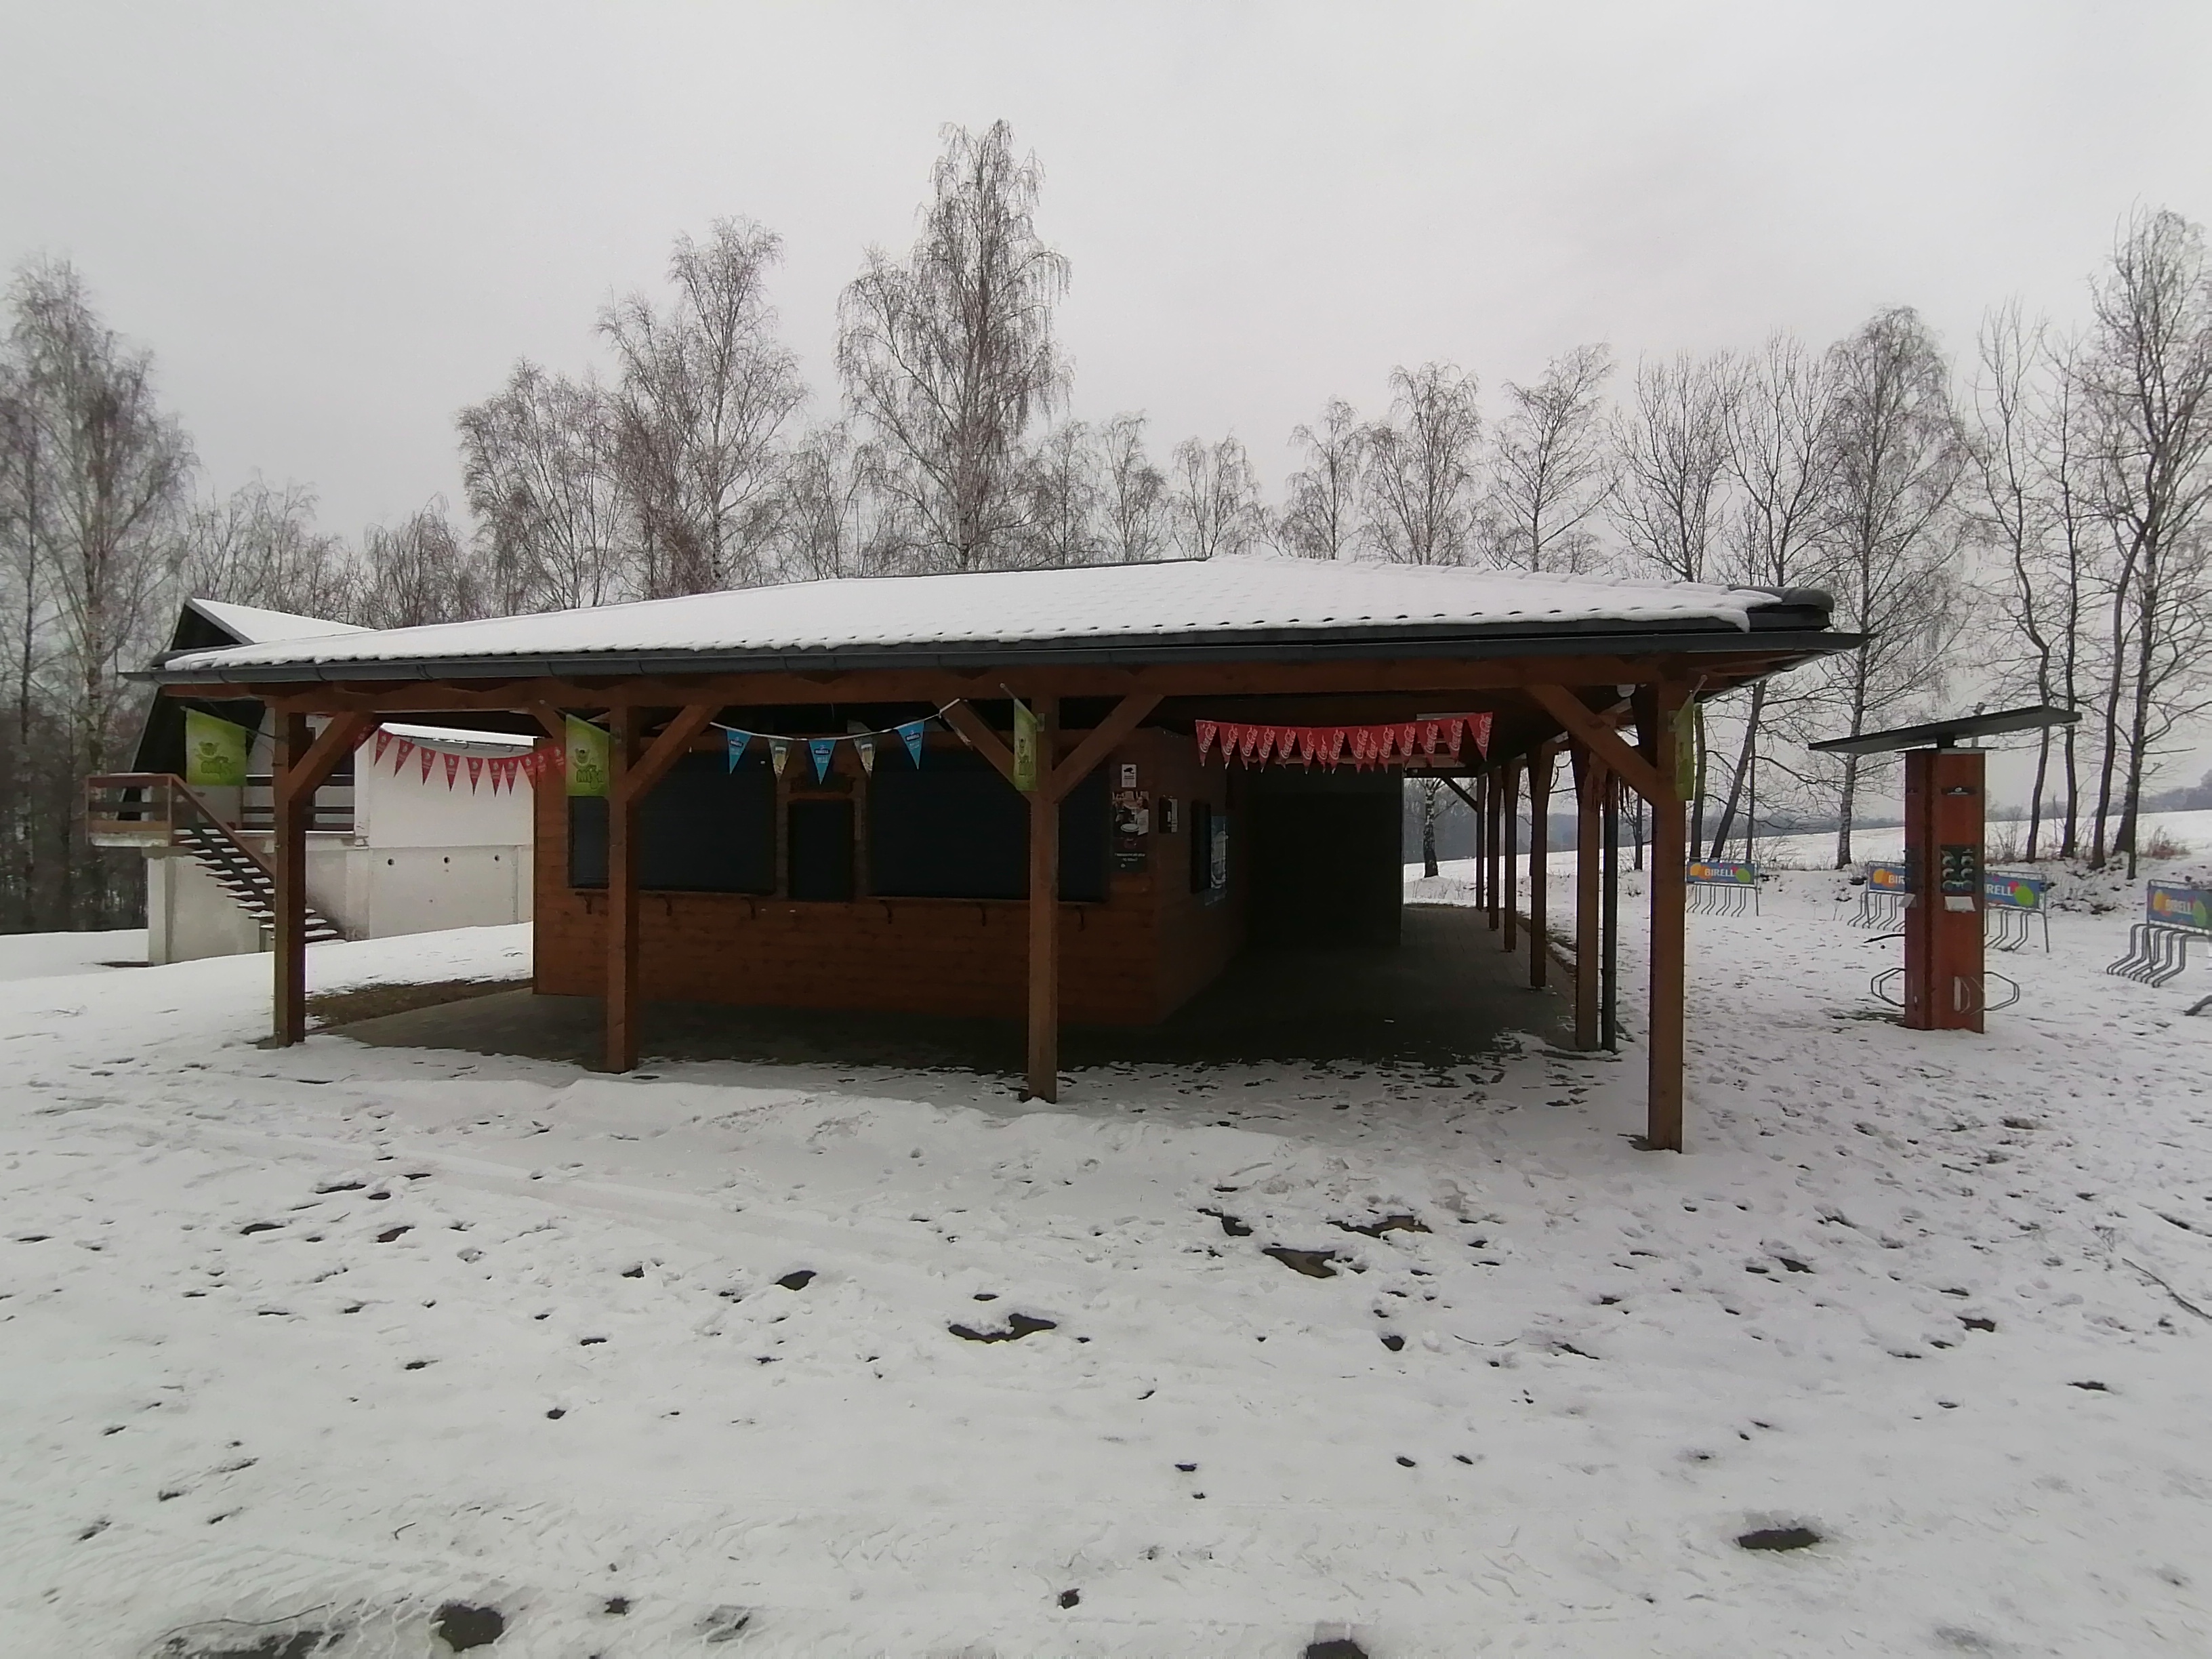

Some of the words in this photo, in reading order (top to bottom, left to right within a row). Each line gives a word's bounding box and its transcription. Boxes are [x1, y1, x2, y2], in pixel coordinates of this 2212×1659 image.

[1704, 868, 1735, 877] BIRELL
[1888, 874, 1906, 884] BIR
[1986, 884, 2014, 897] RELL
